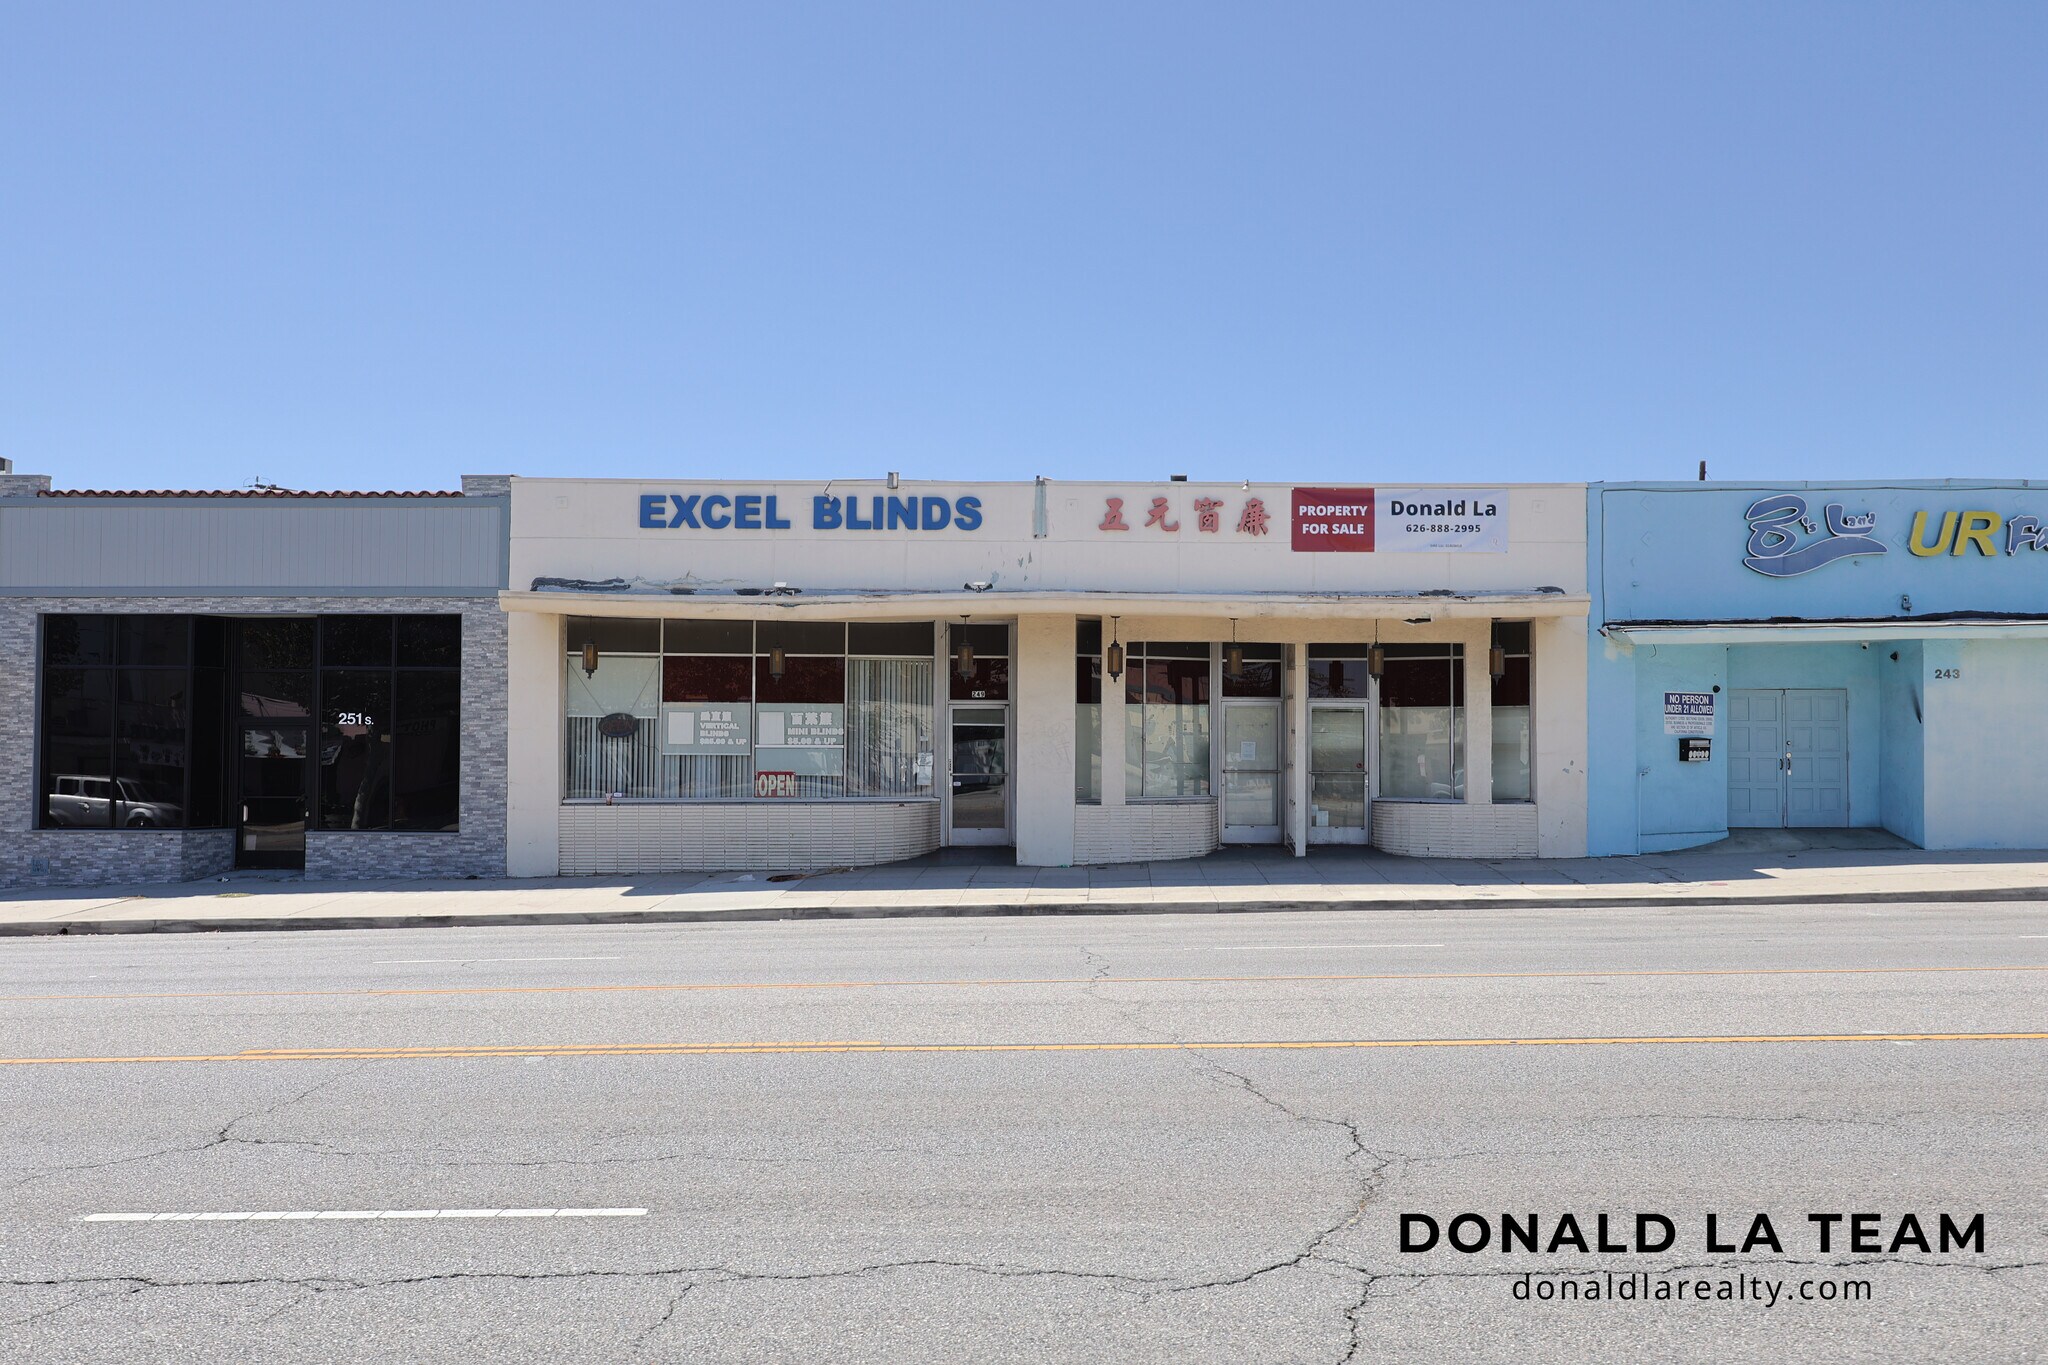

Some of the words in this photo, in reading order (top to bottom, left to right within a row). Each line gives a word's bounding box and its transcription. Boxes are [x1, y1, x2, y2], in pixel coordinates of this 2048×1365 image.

[639, 495, 791, 529] EXCEL
[813, 496, 983, 531] BLINDS
[1299, 505, 1368, 517] PROPERTY
[1391, 500, 1466, 516] Donald
[1473, 500, 1497, 516] La
[1302, 523, 1329, 535] FOR
[1332, 523, 1365, 535] SALE
[1406, 524, 1481, 533] 626-888-2995
[1908, 510, 2002, 557] UR
[1934, 669, 1960, 679] 243
[1669, 695, 1680, 704] NO
[1682, 695, 1709, 704] PERSON
[1665, 704, 1682, 713] UNDER
[1683, 704, 1690, 714] 21
[1690, 705, 1713, 714] ALLOWED
[339, 712, 362, 725] 251
[700, 722, 739, 730] VERTICAL
[787, 727, 808, 735] MINI
[811, 727, 844, 736] BLINDS
[758, 774, 795, 797] OPEN
